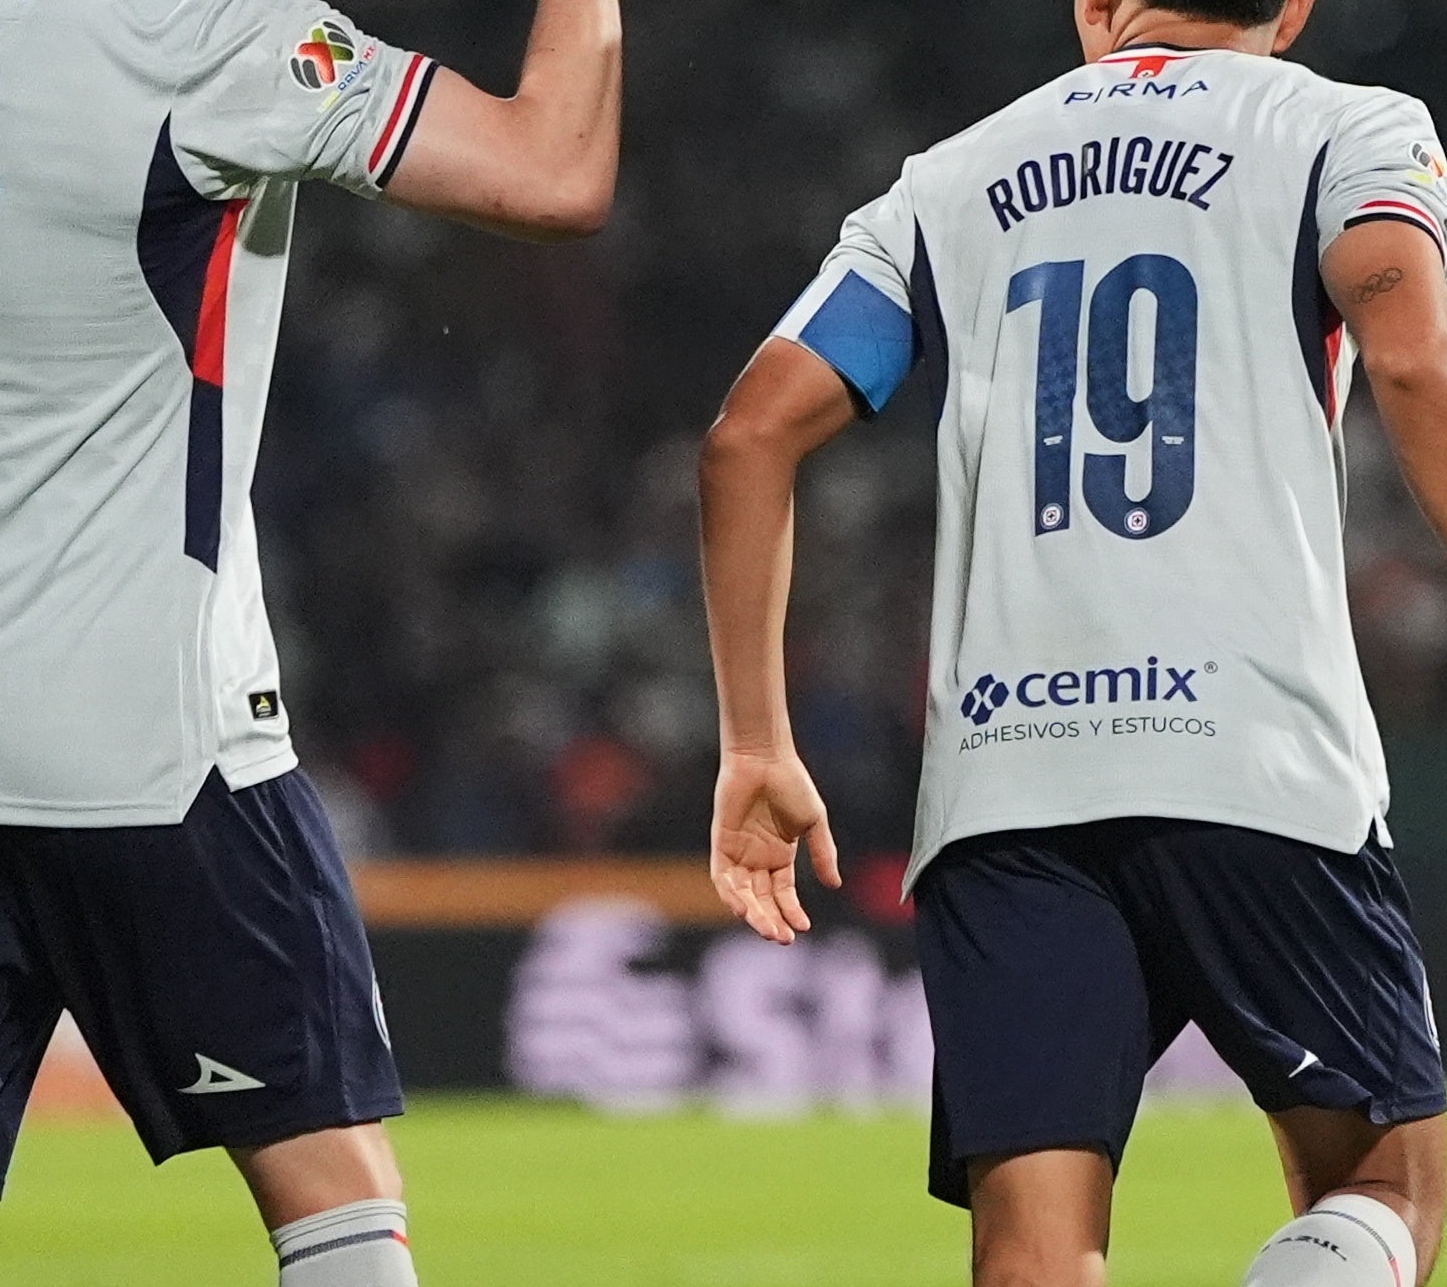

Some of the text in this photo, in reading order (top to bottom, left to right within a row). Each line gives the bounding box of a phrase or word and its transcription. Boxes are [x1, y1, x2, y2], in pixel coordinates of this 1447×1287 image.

[1064, 80, 1209, 105] PIRMA
[986, 136, 1235, 233] RODRIGUEZ
[1006, 253, 1198, 540] 19
[958, 716, 1217, 755] ADHESIVOS Y ESTUCOS
